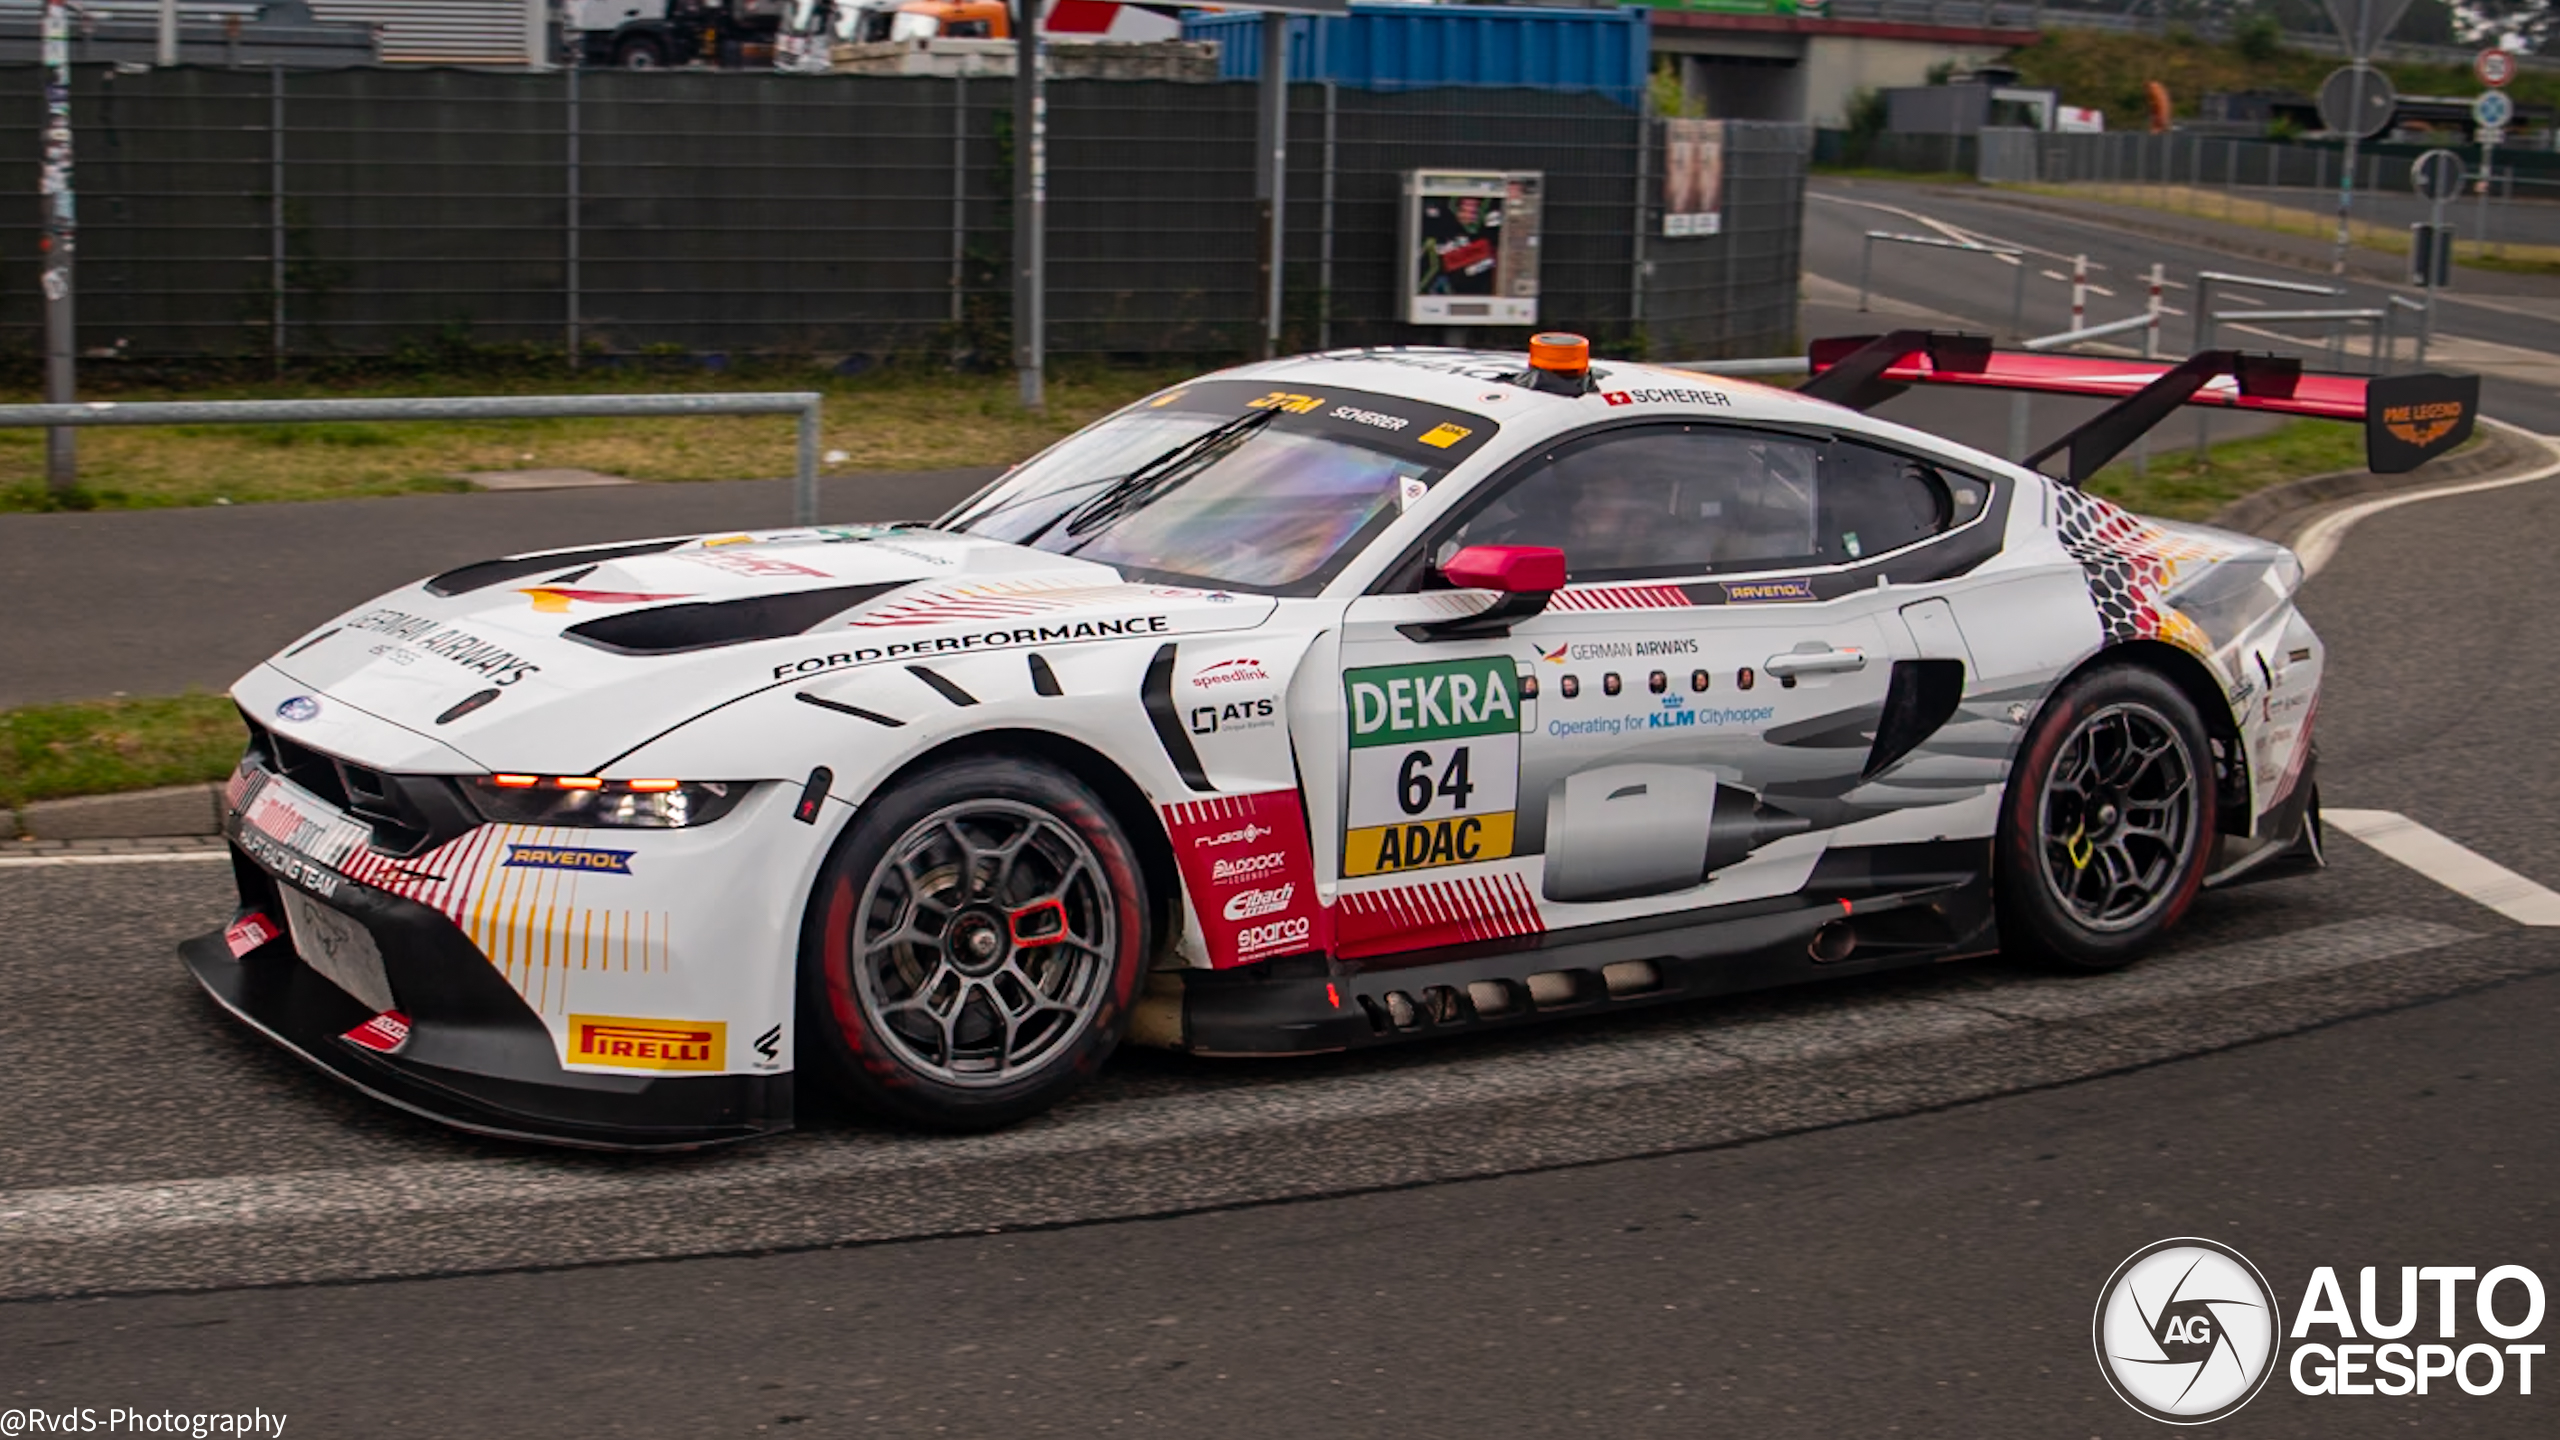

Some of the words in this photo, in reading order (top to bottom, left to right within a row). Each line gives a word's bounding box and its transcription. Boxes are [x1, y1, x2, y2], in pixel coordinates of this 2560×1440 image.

[1632, 387, 1732, 407] SCHERER
[1329, 405, 1409, 432] SCHERER
[1731, 582, 1805, 599] RAVENOL
[416, 628, 541, 686] AIRWAYS
[772, 648, 882, 680] FORD
[887, 615, 1169, 658] PERFORMANCE
[1571, 643, 1633, 661] GERMAN
[1636, 638, 1699, 657] AIRWAYS
[1192, 669, 1269, 689] speedlink
[1222, 699, 1273, 721] ATS
[1352, 670, 1515, 735] DEKRA
[1548, 716, 1621, 739] Operating
[1624, 715, 1644, 730] for
[1649, 709, 1695, 728] KLM
[1699, 706, 1775, 726] Cityhopper
[1397, 746, 1474, 815] 64
[513, 848, 624, 868] RAVENOL
[1376, 818, 1481, 870] ADAC
[1212, 851, 1286, 880] PADDOCK
[300, 866, 340, 899] TEAM
[1223, 884, 1292, 920] Eibach
[1238, 916, 1309, 952] sparco
[580, 1024, 712, 1061] PIRELLI
